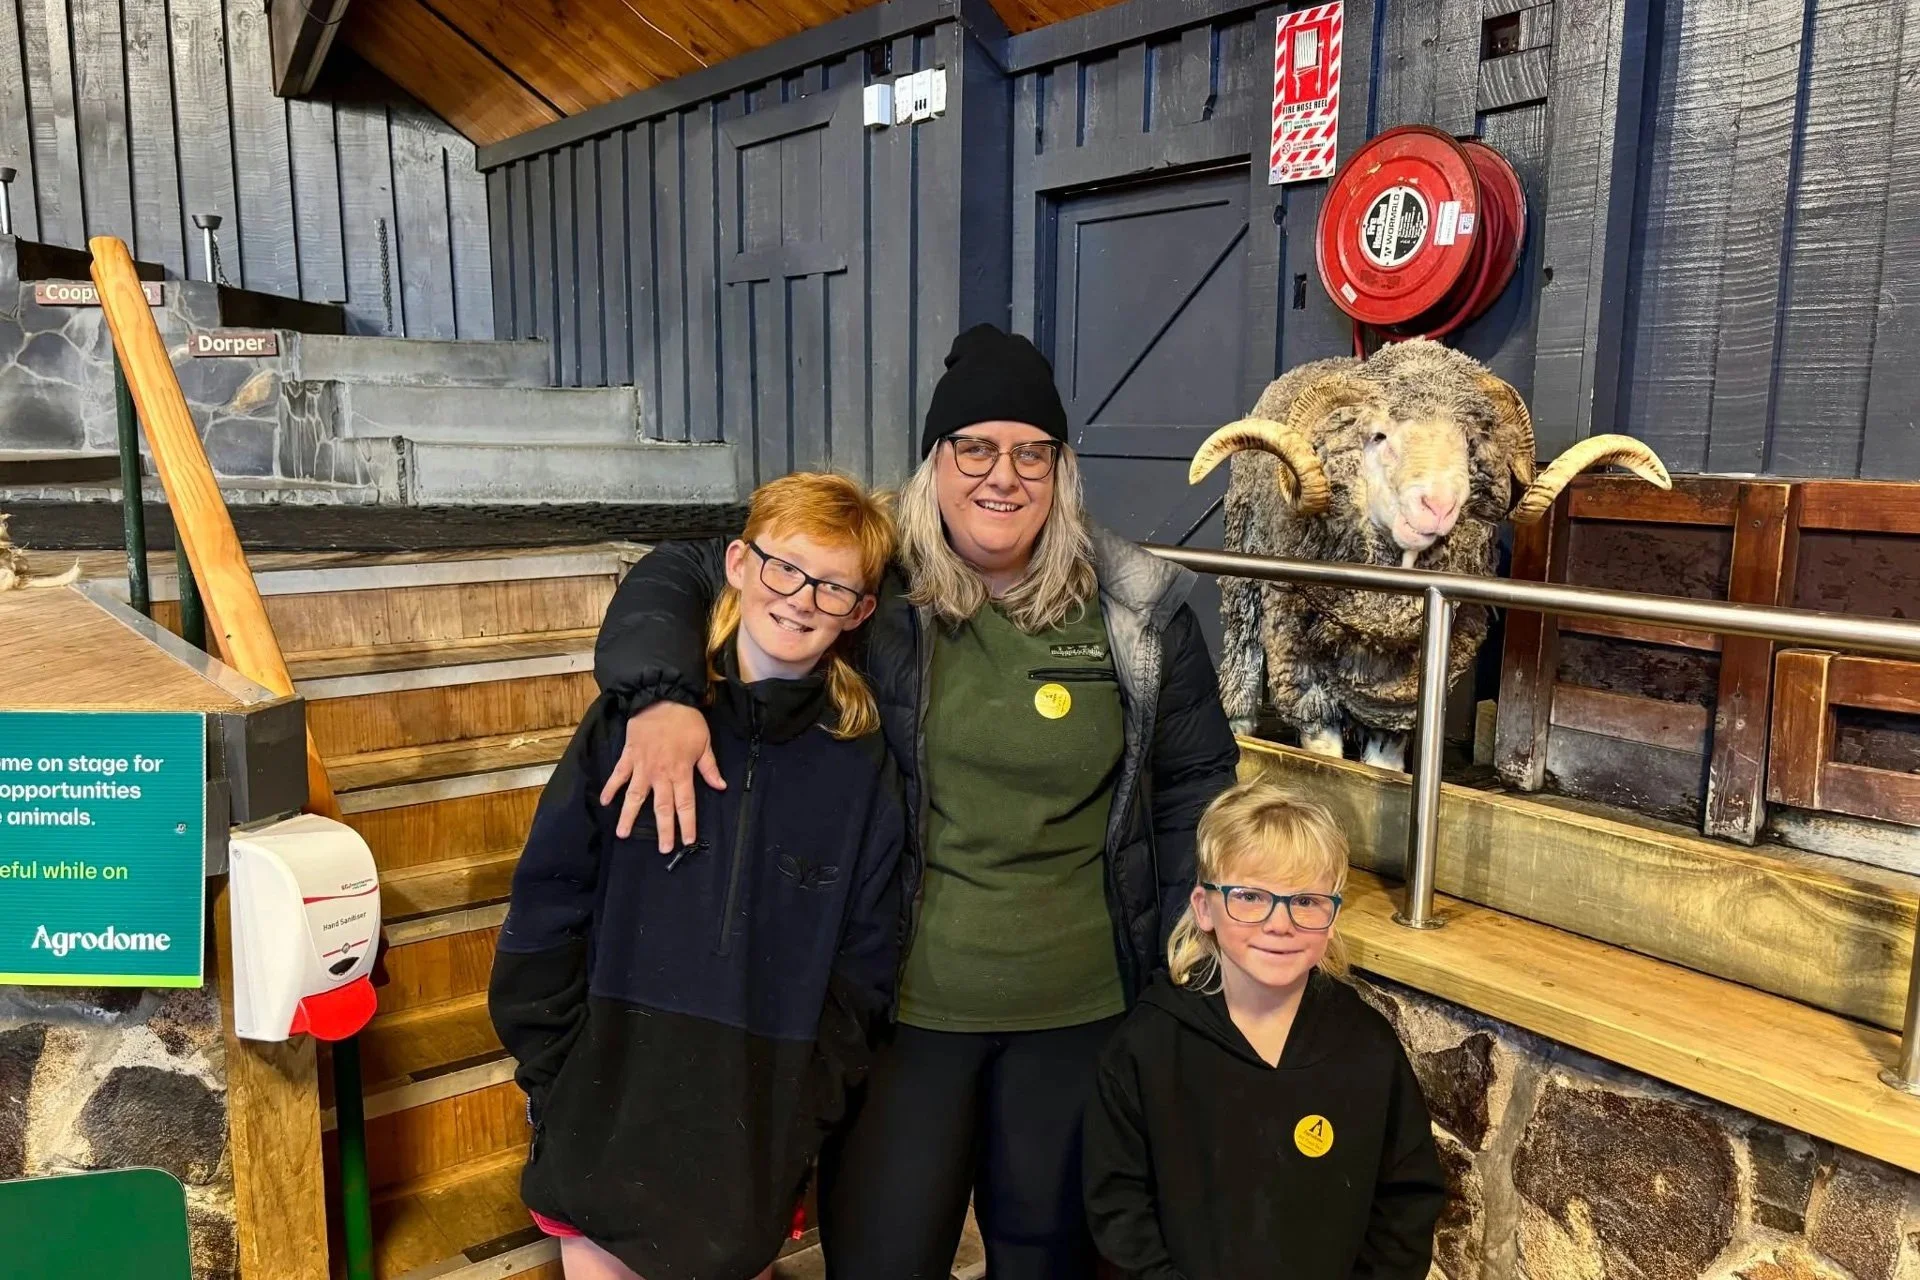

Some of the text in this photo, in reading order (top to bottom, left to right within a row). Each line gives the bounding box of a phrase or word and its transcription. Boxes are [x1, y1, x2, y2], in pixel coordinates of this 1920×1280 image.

[1282, 99, 1328, 115] FIRE HOSE REEL
[1386, 193, 1400, 245] WORMALD
[45, 284, 152, 303] Cooph
[198, 335, 266, 355] Dorper
[0, 754, 164, 776] me on stage for
[0, 781, 142, 803] opportunities
[7, 807, 96, 826] animals.
[0, 861, 128, 880] eful while on
[323, 912, 367, 931] Hand Sanitiser
[31, 924, 172, 957] Agrodome
